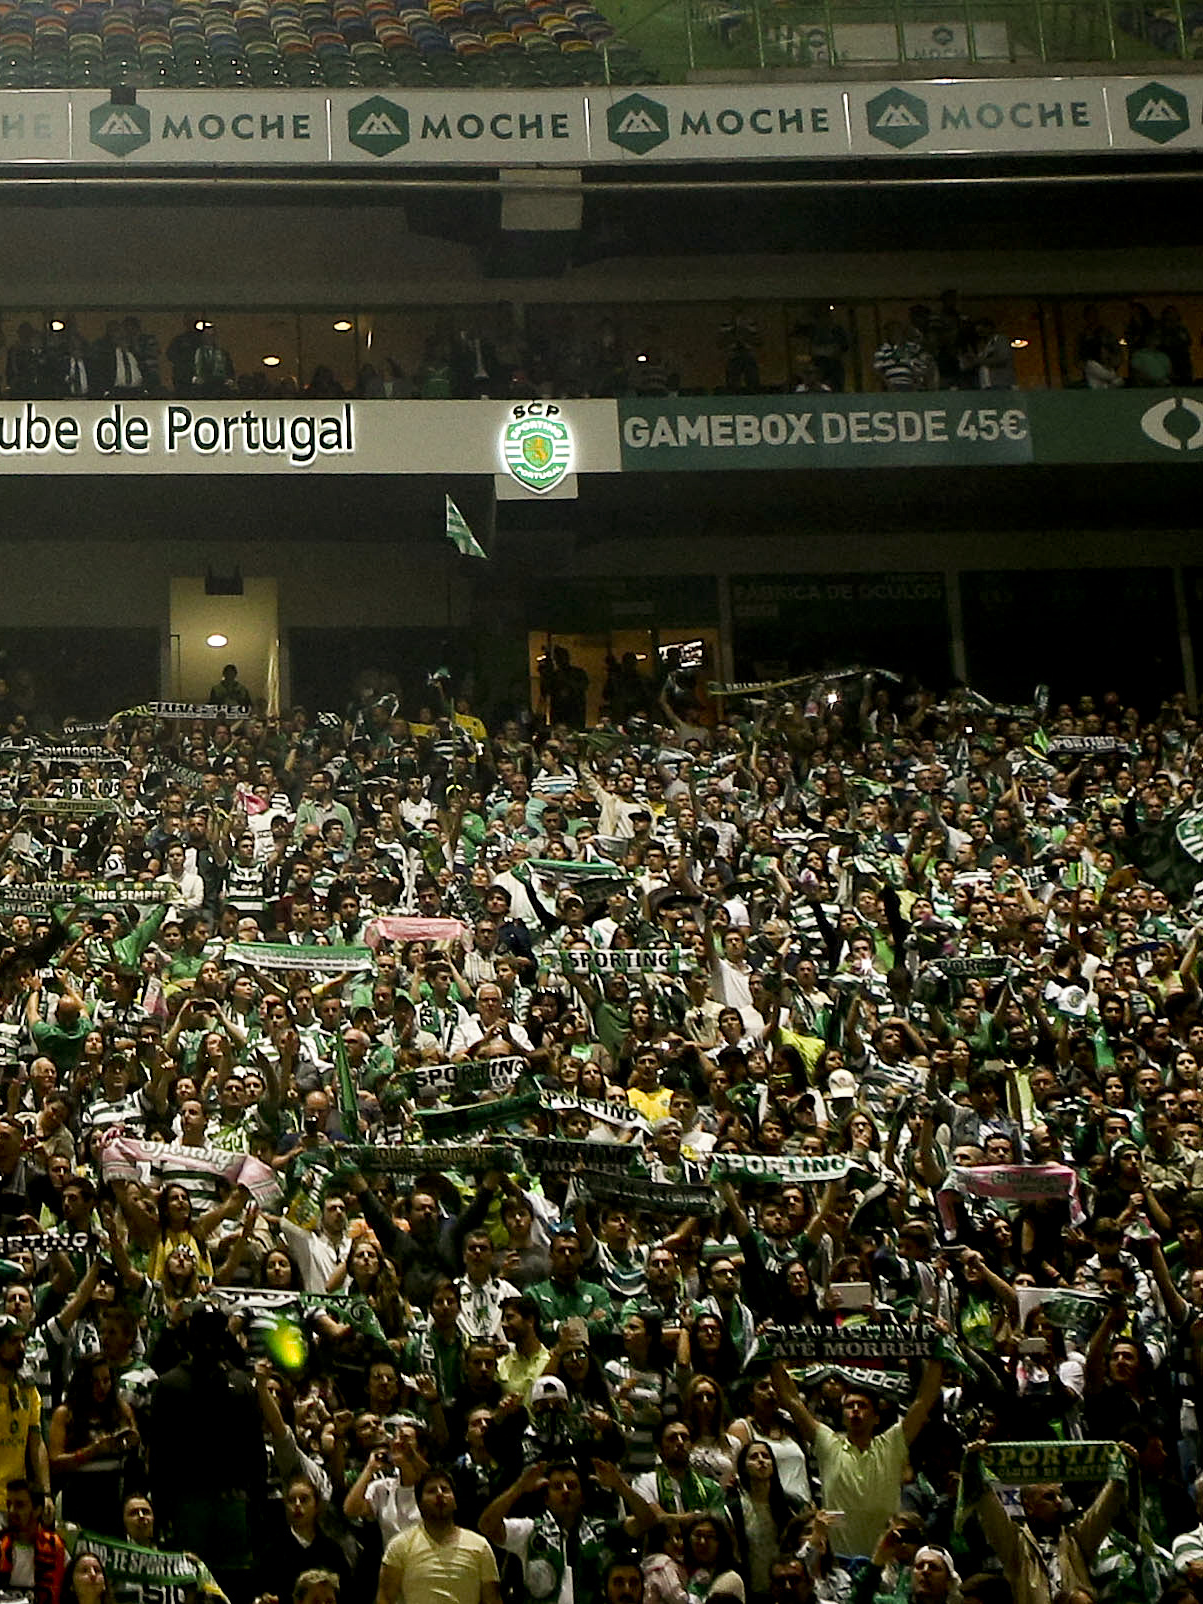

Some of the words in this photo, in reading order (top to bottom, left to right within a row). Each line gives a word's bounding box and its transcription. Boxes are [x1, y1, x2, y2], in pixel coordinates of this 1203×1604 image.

[162, 113, 311, 141] MOCHE
[420, 113, 570, 141] MOCHE
[680, 107, 829, 136] MOCHE
[941, 102, 1091, 130] MOCHE
[513, 402, 560, 419] SCP
[96, 404, 150, 452] de
[168, 404, 353, 464] Portugal
[624, 414, 815, 449] GAMEBOX
[820, 410, 949, 445] DESDE
[957, 408, 1028, 442] 45€
[568, 952, 671, 968] SPORTING
[715, 1154, 846, 1176] SPORTING
[823, 1341, 933, 1358] MORRER
